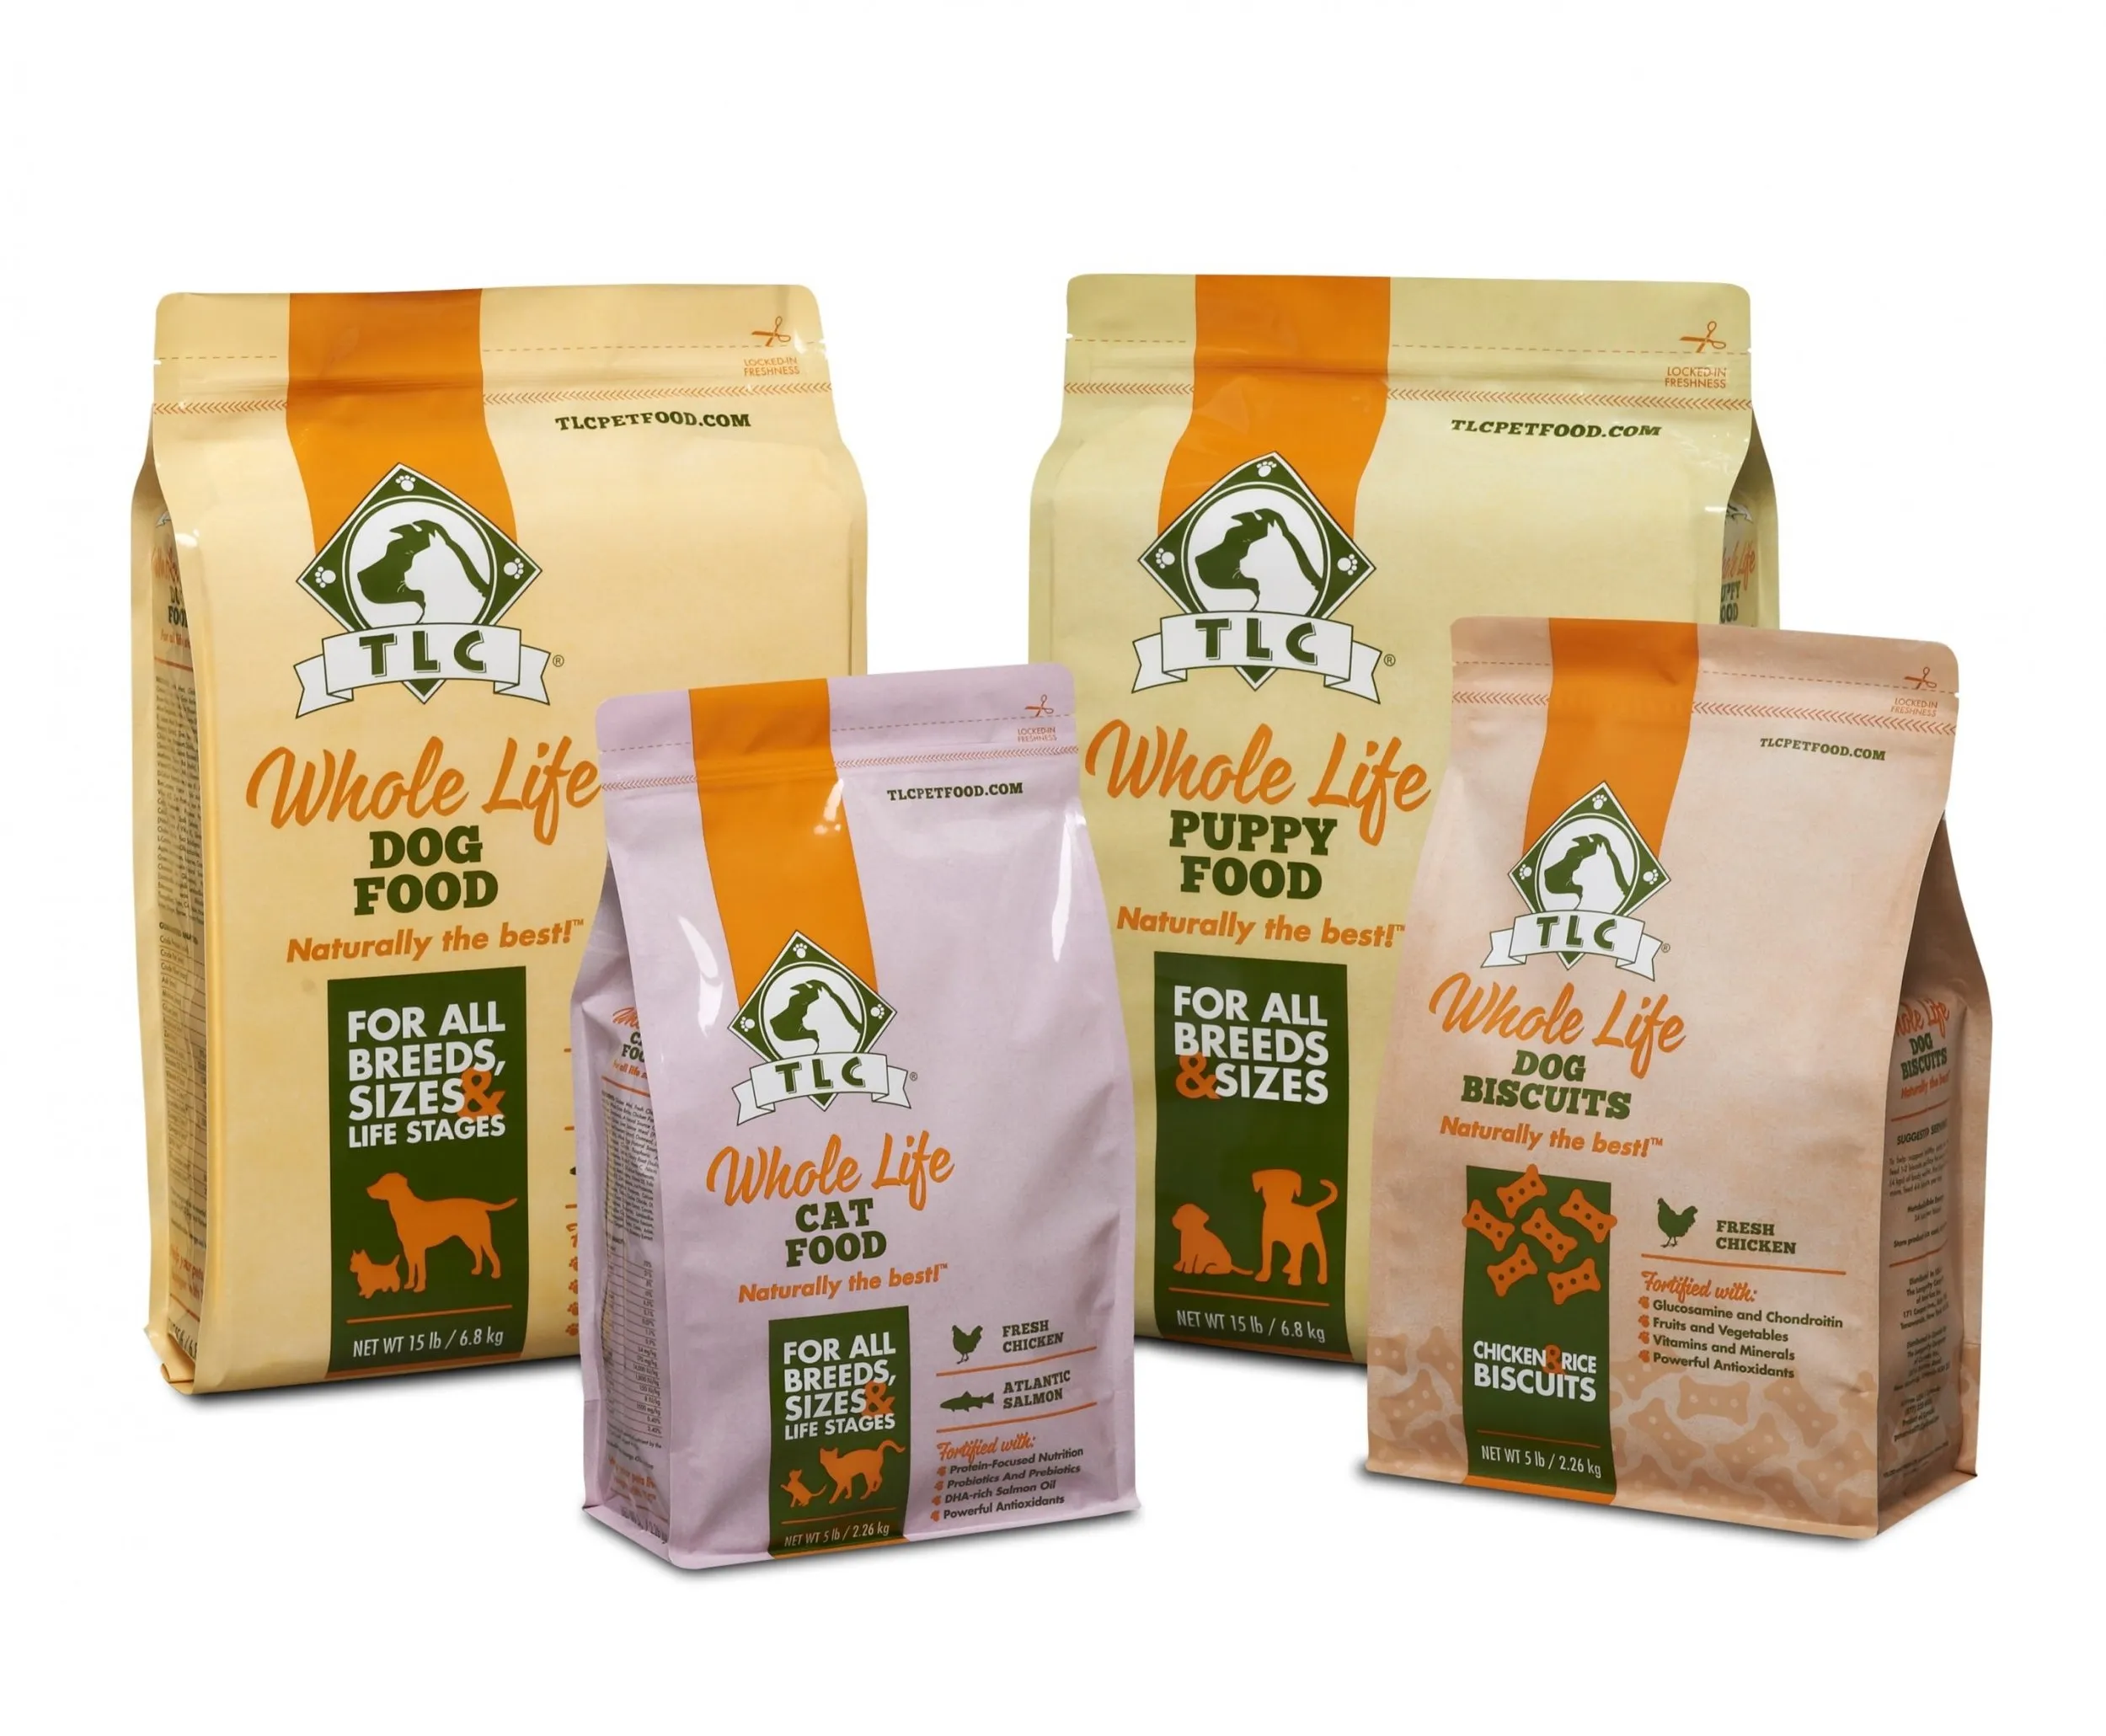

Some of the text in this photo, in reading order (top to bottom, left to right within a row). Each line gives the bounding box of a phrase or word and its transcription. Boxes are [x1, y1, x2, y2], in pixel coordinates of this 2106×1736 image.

[744, 357, 798, 366] LOCKED-IN
[744, 366, 800, 377] FRESHNESS
[1667, 366, 1726, 378] LOCKED-IN
[1665, 377, 1726, 389] FRESHNESS
[554, 411, 751, 430] TLCPETFOOD.COM
[1451, 419, 1662, 438] TLCPETFOOD.COM
[1720, 602, 1739, 624] OOD
[359, 630, 489, 676] TLC
[1195, 617, 1318, 665] TLC
[1890, 706, 1937, 718] FRESHNESS
[1895, 697, 1938, 708] LOCKED-IN
[1018, 726, 1056, 736] LOCKED-IN
[1018, 734, 1057, 743] FRESHNESS
[1760, 738, 1886, 761] TLCPETFOOD.COM
[245, 735, 470, 829] Whole
[481, 735, 602, 846] Life
[887, 783, 1024, 801] TLCPETFOOD.COM
[1085, 718, 1431, 847] Whole Life
[369, 825, 483, 869] DOG
[1169, 809, 1337, 856] PUPPY
[354, 870, 499, 916] FOOD
[1180, 855, 1323, 900] FOOD
[1116, 906, 1256, 945] Naturally
[1264, 914, 1311, 943] the
[1537, 915, 1617, 951] TLC
[286, 928, 433, 962] Naturally
[442, 925, 489, 952] the
[1174, 985, 1328, 1027] FOR ALL
[348, 1001, 505, 1043] FOR ALL
[1429, 972, 1686, 1080] Whole Life
[1174, 1022, 1328, 1066] BREEDS
[1909, 1033, 1933, 1055] DOG
[349, 1039, 505, 1082] BREEDS,
[775, 1056, 866, 1093] TLC
[1511, 1050, 1586, 1082] DOG
[1900, 1048, 1948, 1081] BISCUITS
[1461, 1075, 1632, 1120] BISCUITS
[349, 1114, 505, 1148] LIFE STAGES
[1440, 1115, 1543, 1151] Naturally
[1549, 1128, 1585, 1151] the
[706, 1134, 863, 1206] Whole
[871, 1130, 955, 1211] Life
[795, 1198, 874, 1232] CAT
[1716, 1220, 1775, 1237] FRESH
[785, 1231, 887, 1268] FOOD
[1716, 1237, 1797, 1254] CHICKEN
[739, 1275, 842, 1303] Naturally
[848, 1271, 881, 1291] the
[1641, 1270, 1757, 1303] Fortified with:
[1002, 1320, 1050, 1338] FRESH
[1177, 1310, 1200, 1327] NET
[1205, 1312, 1225, 1330] WT
[1230, 1315, 1246, 1332] 15
[1250, 1315, 1263, 1334] lb
[1281, 1320, 1303, 1338] 6.8
[1307, 1321, 1325, 1343] kg
[1653, 1300, 1843, 1328] Glucosamine and Chondroitin
[353, 1339, 379, 1358] NET
[383, 1337, 404, 1354] WT
[409, 1334, 425, 1351] 15
[429, 1332, 441, 1349] lb
[459, 1328, 482, 1347] 6.8
[487, 1327, 504, 1346] kg
[1002, 1332, 1064, 1353] CHICKEN
[1653, 1317, 1789, 1343] Fruits and Vegetables
[783, 1332, 896, 1365] FOR ALL
[1653, 1334, 1795, 1361] Vitamins and Minerals
[784, 1359, 896, 1393] BREEDS,
[1653, 1352, 1795, 1379] Powerful Antioxidants
[1002, 1370, 1071, 1394] ATLANTIC
[1474, 1362, 1596, 1402] BISCUITS
[1002, 1388, 1063, 1410] SALMON
[784, 1413, 895, 1440] LIFE STAGES
[937, 1432, 1036, 1463] Fortified with:
[950, 1447, 1084, 1474] Protein-Focused Nutrition
[1482, 1445, 1501, 1461] NET
[1504, 1448, 1521, 1464] WT
[1525, 1450, 1531, 1466] 5
[1535, 1450, 1545, 1467] lb
[1559, 1456, 1584, 1472] 2.26
[1587, 1459, 1601, 1478] kg
[945, 1479, 1056, 1504] DHA-rich Salmon Oil
[947, 1464, 1081, 1489] Probiotics And Prebiotics
[943, 1495, 1065, 1520] Powerful Antioxidants
[784, 1534, 803, 1547] NET
[805, 1531, 821, 1544] WT
[823, 1530, 830, 1542] 5
[831, 1526, 840, 1541] lb
[853, 1524, 874, 1538] 2.26
[877, 1523, 890, 1536] kg
